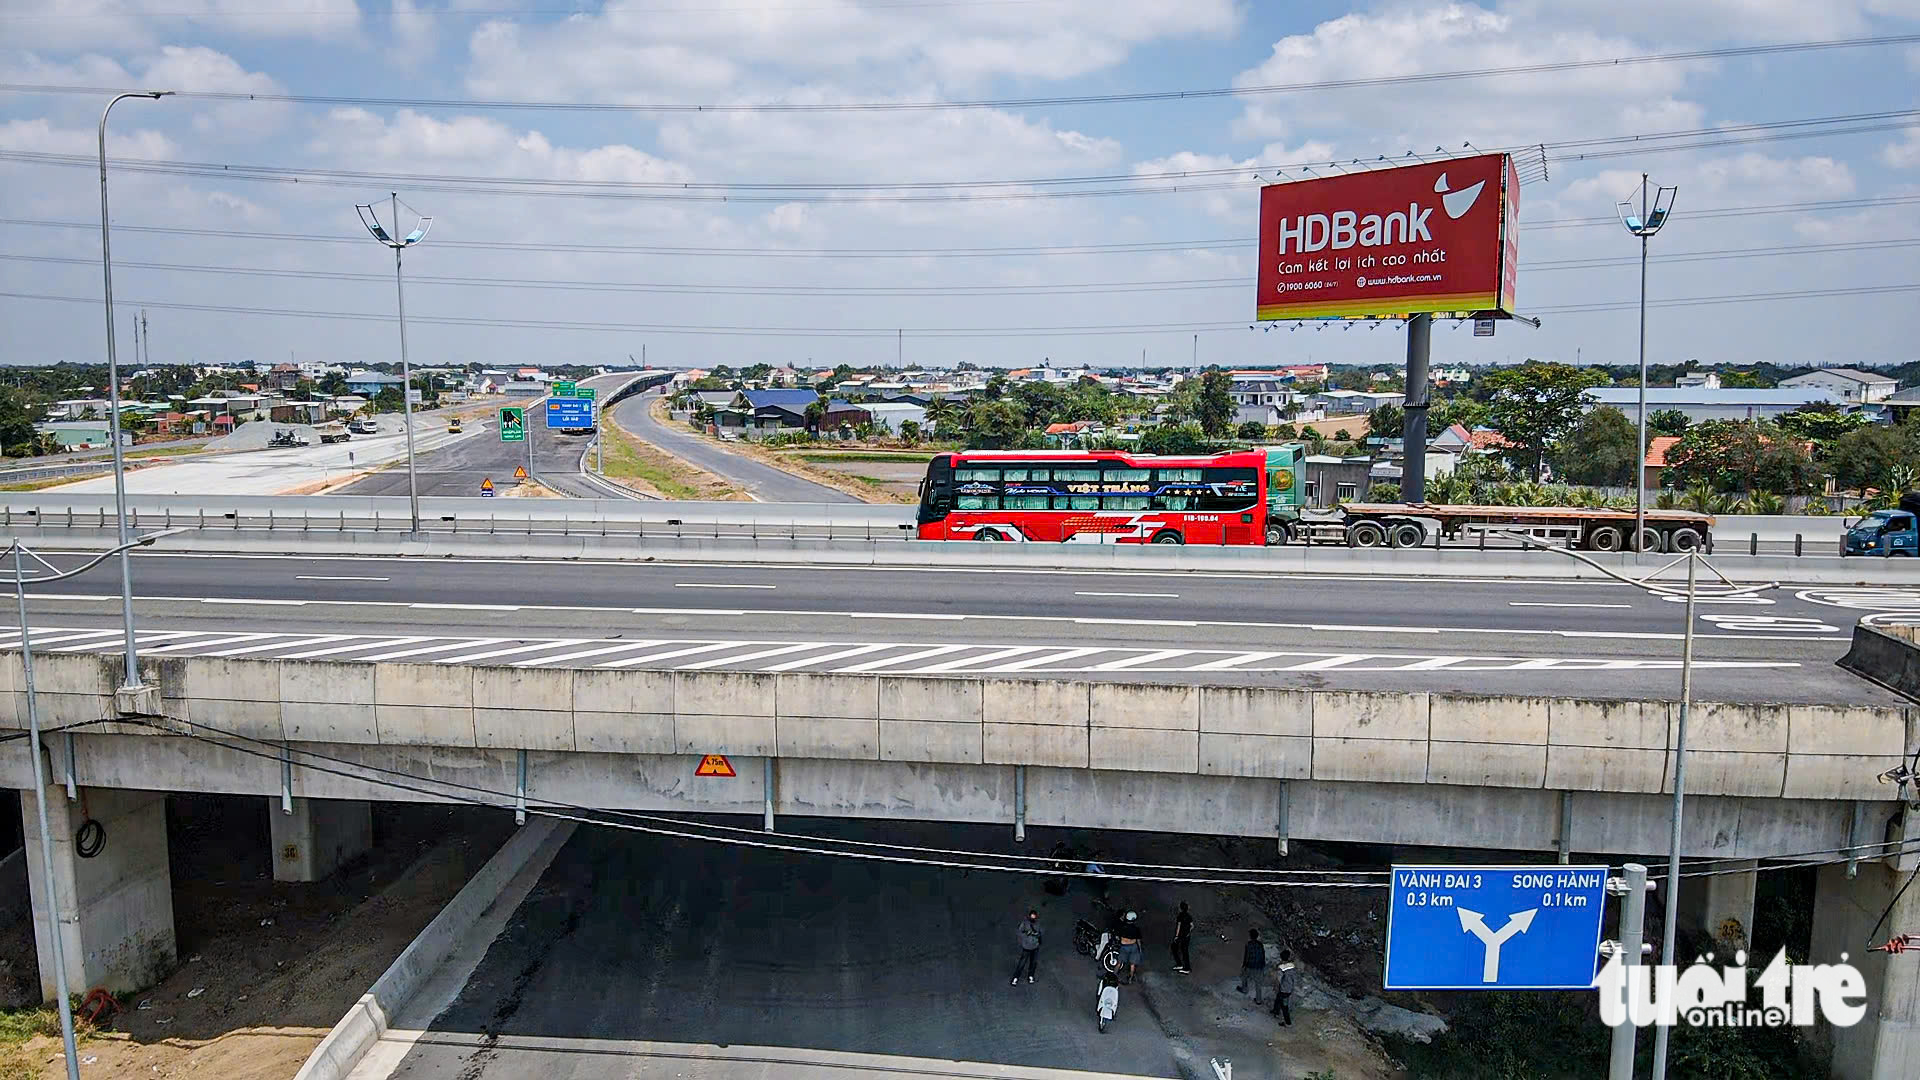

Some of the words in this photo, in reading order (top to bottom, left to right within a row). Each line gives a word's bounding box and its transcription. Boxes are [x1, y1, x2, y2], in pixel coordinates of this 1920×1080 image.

[1279, 202, 1434, 255] HDBank
[1278, 261, 1303, 275] Cam
[1308, 258, 1329, 272] kết
[1357, 253, 1375, 268] ích
[1382, 254, 1407, 266] cao
[1413, 248, 1447, 264] nhất
[1286, 282, 1303, 291] 1900
[1304, 280, 1323, 290] 6060
[1367, 274, 1442, 286] www.hdbank.com.vn
[1067, 483, 1100, 493] VIỆT
[1399, 870, 1441, 889] VÀNH
[1445, 875, 1470, 889] ĐAI
[1473, 875, 1482, 889] 3
[1512, 874, 1554, 889] SONG
[1557, 871, 1600, 888] HÀNH
[1406, 892, 1427, 906] 0.3
[1430, 892, 1454, 906] km
[1542, 893, 1561, 906] 0.1
[1564, 893, 1587, 906] km
